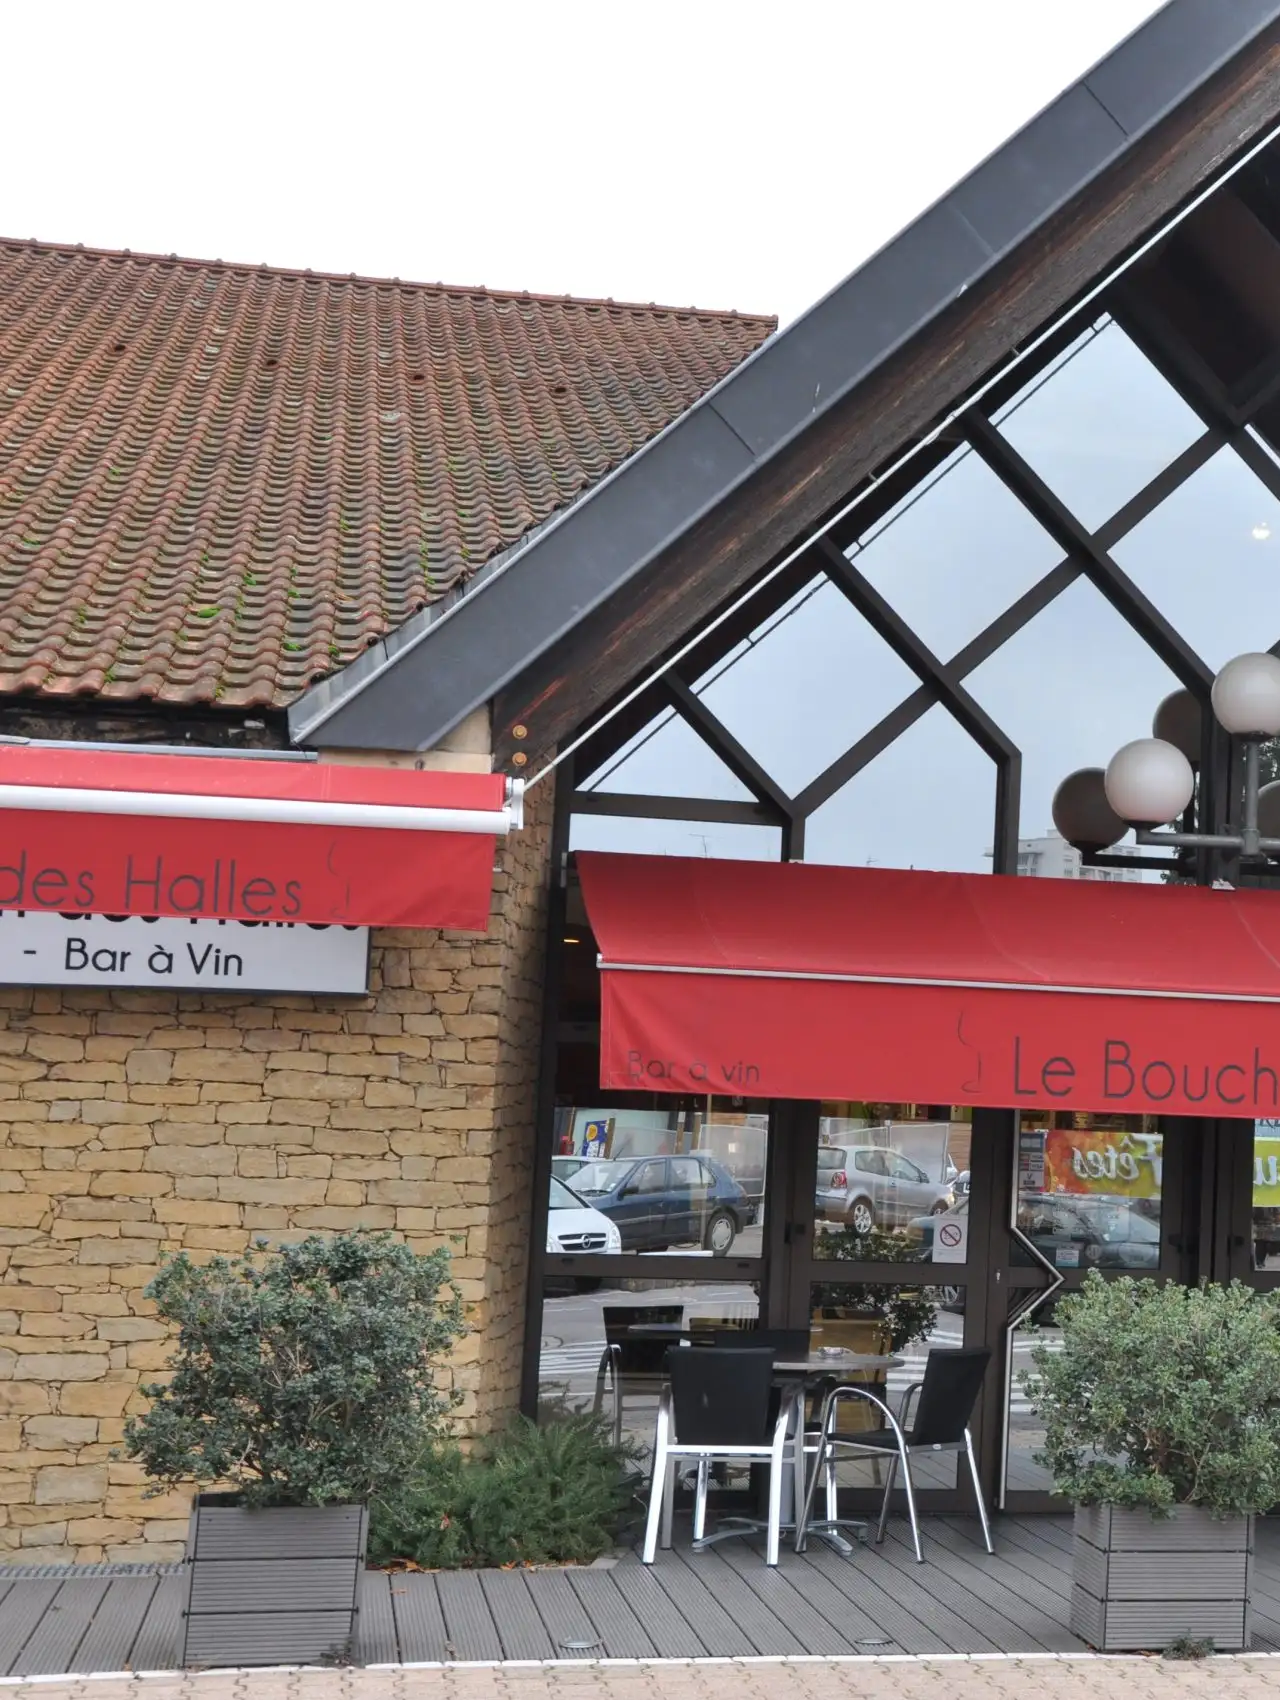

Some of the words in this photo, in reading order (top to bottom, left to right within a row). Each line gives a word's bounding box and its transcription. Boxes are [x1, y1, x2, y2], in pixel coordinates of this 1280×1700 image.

[123, 855, 304, 917] Halles
[64, 937, 132, 974] Bar
[147, 945, 175, 975] à
[186, 942, 244, 977] Vin
[627, 1050, 675, 1081] Bar
[720, 1060, 761, 1083] vin
[1013, 1035, 1076, 1098] Le
